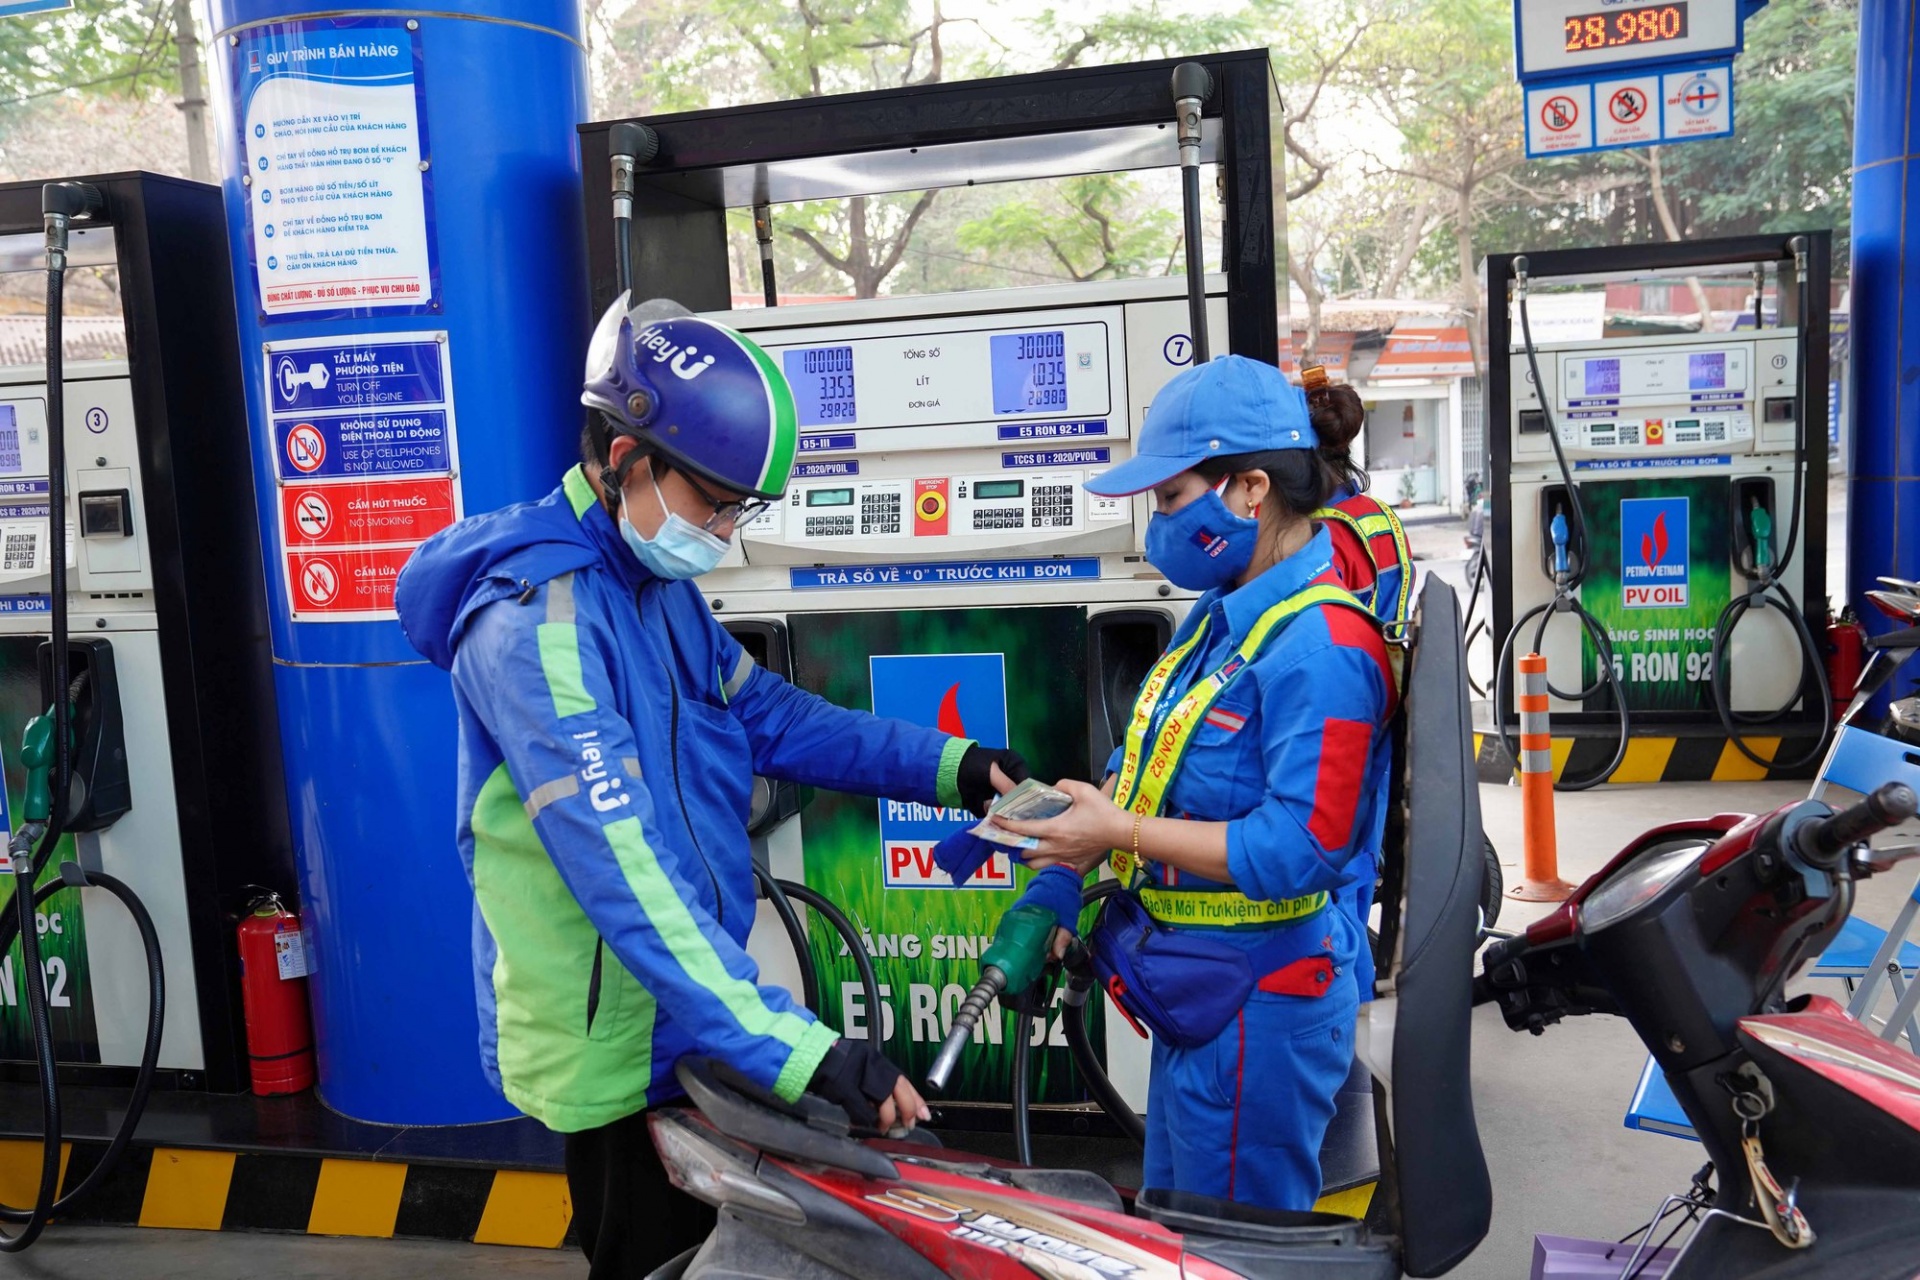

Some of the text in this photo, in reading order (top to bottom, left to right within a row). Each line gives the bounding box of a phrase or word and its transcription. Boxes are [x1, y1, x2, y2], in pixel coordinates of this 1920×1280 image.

[1564, 7, 1680, 50] 28.980
[267, 42, 398, 65] QUY TRÌNH BÁN HÀNG
[313, 115, 321, 123] XE
[323, 113, 338, 122] VÀO
[385, 122, 407, 130] HÀNG
[381, 144, 407, 152] KHÁCH
[327, 181, 337, 190] SỐ
[343, 191, 368, 199] KHÁCH
[313, 260, 336, 268] KHÁCH
[327, 286, 335, 297] SỐ
[362, 285, 379, 296] PHỤC
[391, 284, 404, 292] CHU
[903, 347, 940, 359] TỔNG SỐ
[1017, 333, 1064, 360] 30000
[1174, 341, 1184, 357] 7
[334, 351, 376, 364] TẮT MÁY
[804, 348, 853, 374] 100000
[335, 361, 404, 375] PHƯƠNG TIỆN
[336, 381, 380, 392] TURN OFF
[916, 375, 930, 386] LÍT
[337, 392, 403, 404] YOUR ENGINE
[908, 398, 940, 408] ĐƠN GIÁ
[1028, 389, 1066, 406] 28980
[820, 402, 855, 418] 29820
[93, 413, 101, 427] 3
[340, 417, 421, 431] KHÔNG SỬ DỤNG
[341, 427, 441, 442] ĐIỆN THOẠI DI ĐỘNG
[1020, 423, 1085, 436] E5 RON 92-II
[803, 438, 830, 449] 95-III
[343, 446, 441, 460] USE OF CELLPHONES
[1014, 450, 1098, 464] TCCS 01 2020/PVOIL
[344, 459, 424, 471] IS NOT ALLOWED
[806, 463, 848, 474] 2020/PVOIL
[348, 494, 427, 510] CẤM HÚT THUỐC
[349, 516, 414, 528] NO SMOKING
[354, 564, 397, 577] CẤM LỬA
[818, 569, 849, 584] TRẢ
[853, 567, 874, 583] SỐ
[879, 567, 900, 582] VỀ
[936, 566, 993, 580] TRƯỚC
[998, 567, 1025, 578] KHI
[1034, 565, 1072, 577] BƠM
[1625, 564, 1684, 578] PETROVIETNAM
[356, 585, 391, 595] NO FIRE
[1626, 587, 1683, 604] PV OIL
[17, 598, 45, 610] BƠM
[1603, 623, 1715, 645] ĂNG SINH HỌC
[1631, 652, 1679, 682] RON
[1686, 654, 1712, 682] 92
[1159, 719, 1182, 759] RON
[1150, 755, 1166, 778] 92
[1117, 752, 1137, 804] E5 RO
[1134, 793, 1152, 816] E5
[890, 847, 1006, 879] PV IL
[1113, 853, 1128, 874] 92
[47, 955, 71, 1008] 2
[841, 982, 895, 1042] E5
[909, 983, 1002, 1045] RON
